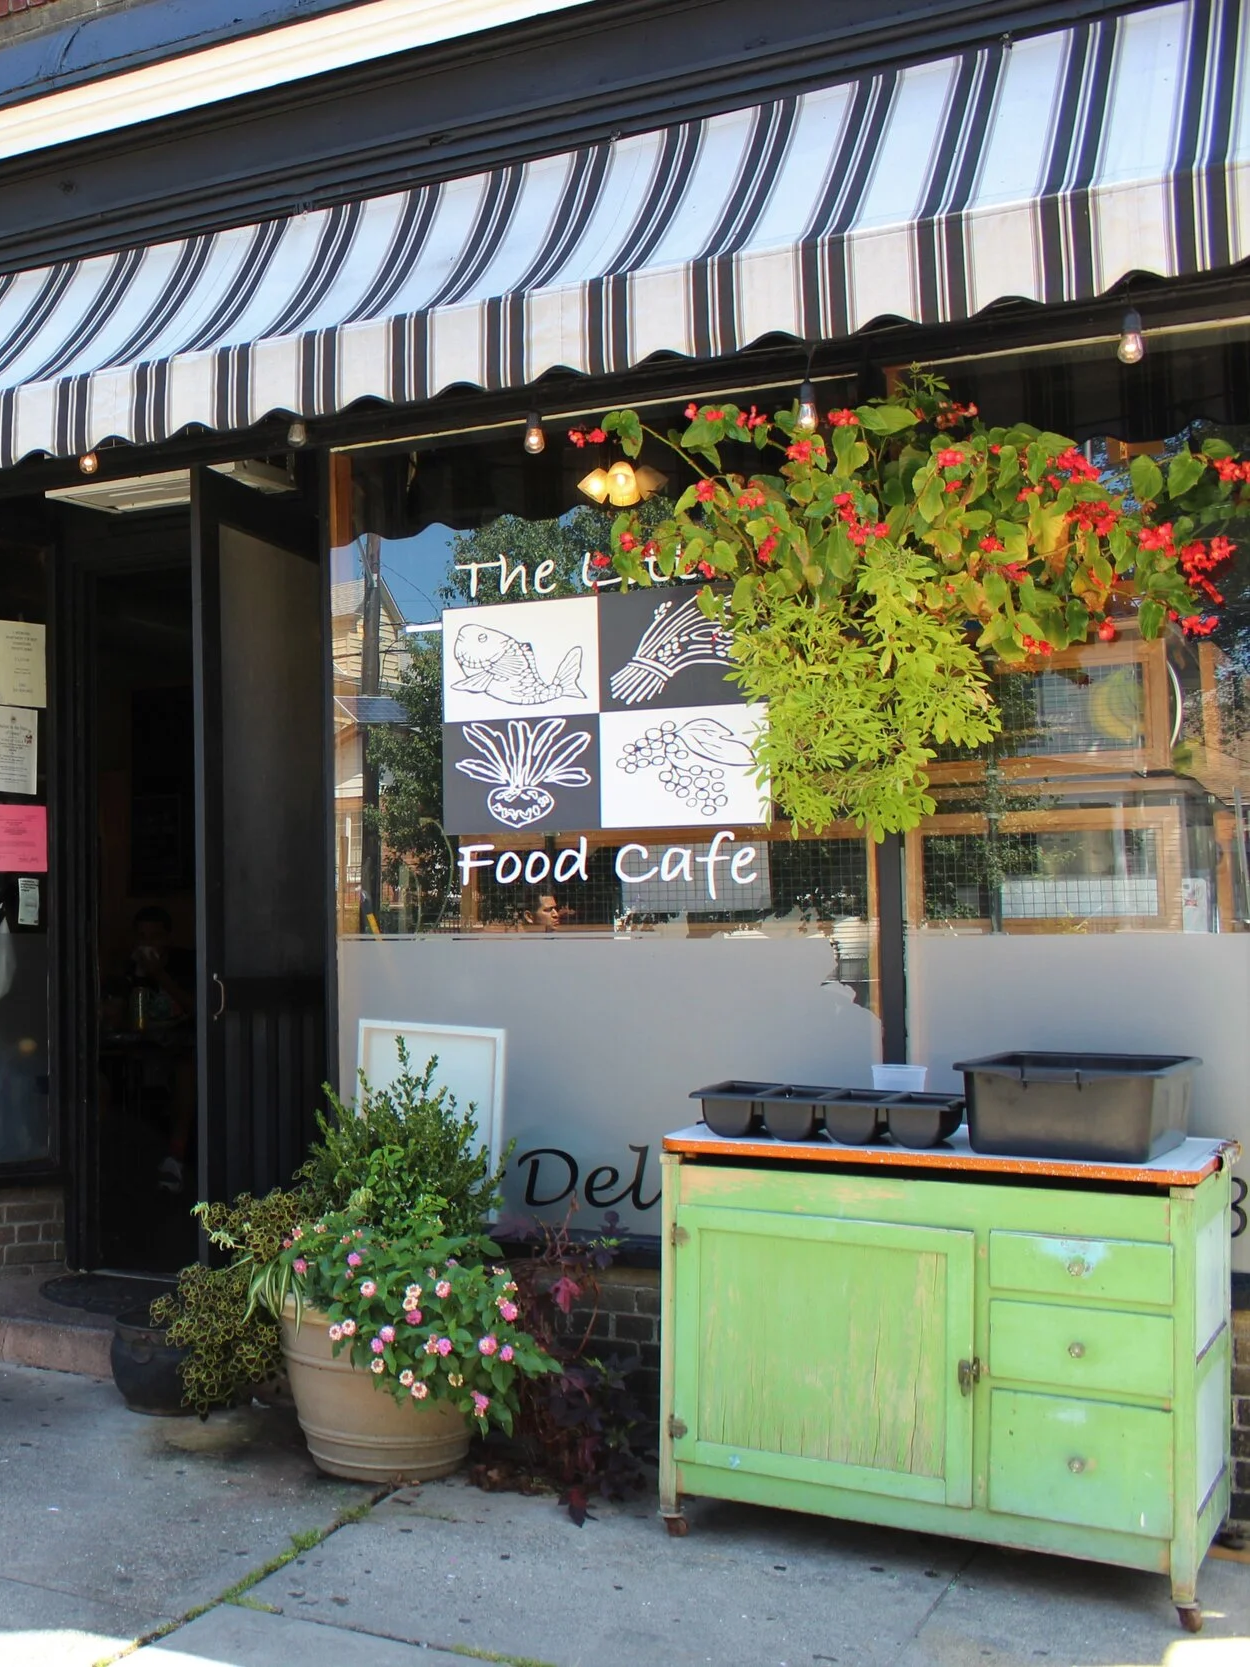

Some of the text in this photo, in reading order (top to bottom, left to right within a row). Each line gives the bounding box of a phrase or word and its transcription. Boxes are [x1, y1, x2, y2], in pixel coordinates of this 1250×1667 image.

[454, 553, 557, 598] The
[457, 831, 757, 900] Food Cafe
[517, 1143, 663, 1211] Del
